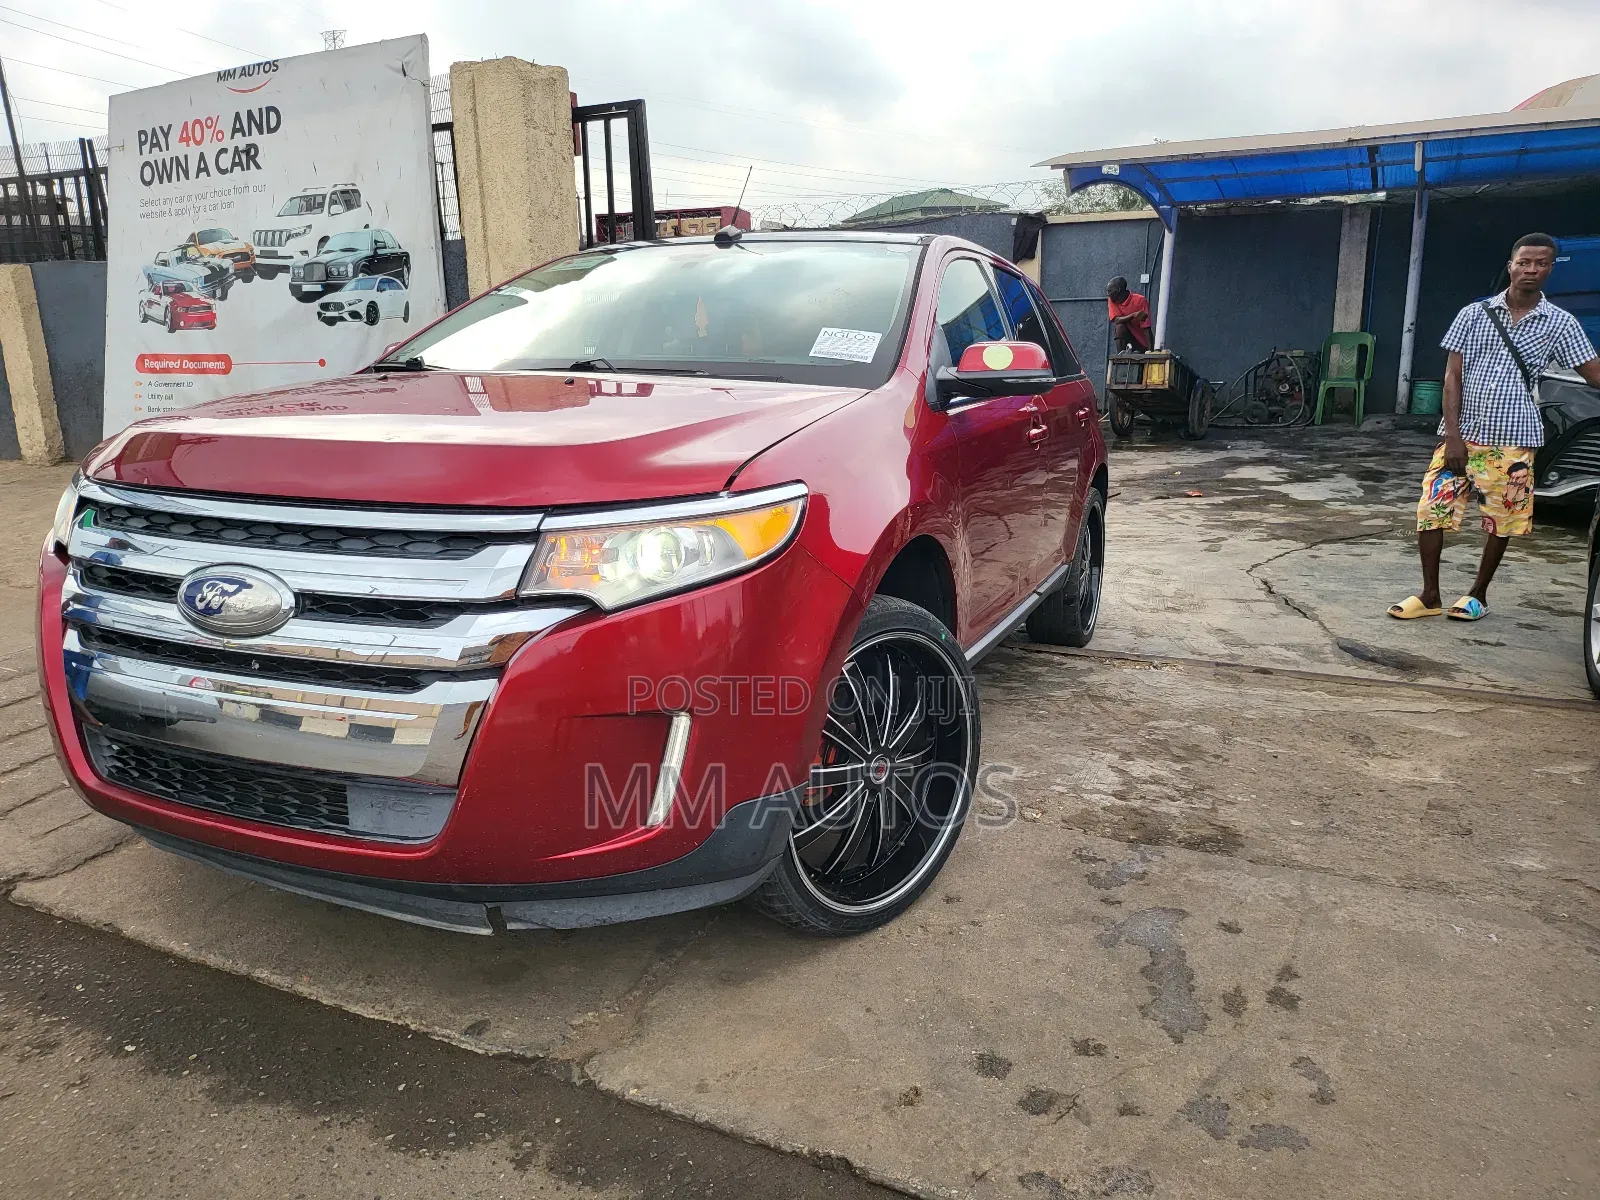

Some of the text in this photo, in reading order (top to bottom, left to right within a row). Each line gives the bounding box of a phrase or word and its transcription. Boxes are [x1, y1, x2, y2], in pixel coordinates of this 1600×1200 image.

[216, 60, 279, 83] MM AUTOS
[137, 105, 282, 156] PAY 40% AND
[140, 143, 262, 187] OWN A CAR
[139, 198, 161, 208] Select
[162, 197, 174, 207] any
[174, 195, 186, 204] car
[194, 191, 209, 203] your
[209, 187, 232, 199] choice
[233, 184, 250, 196] from
[252, 183, 267, 193] our
[139, 200, 235, 219] website & apply for a car loan
[144, 358, 226, 371] Required Documents
[147, 380, 153, 388] A
[153, 380, 186, 388] Government
[147, 392, 164, 402] Utility
[147, 405, 162, 413] Bank
